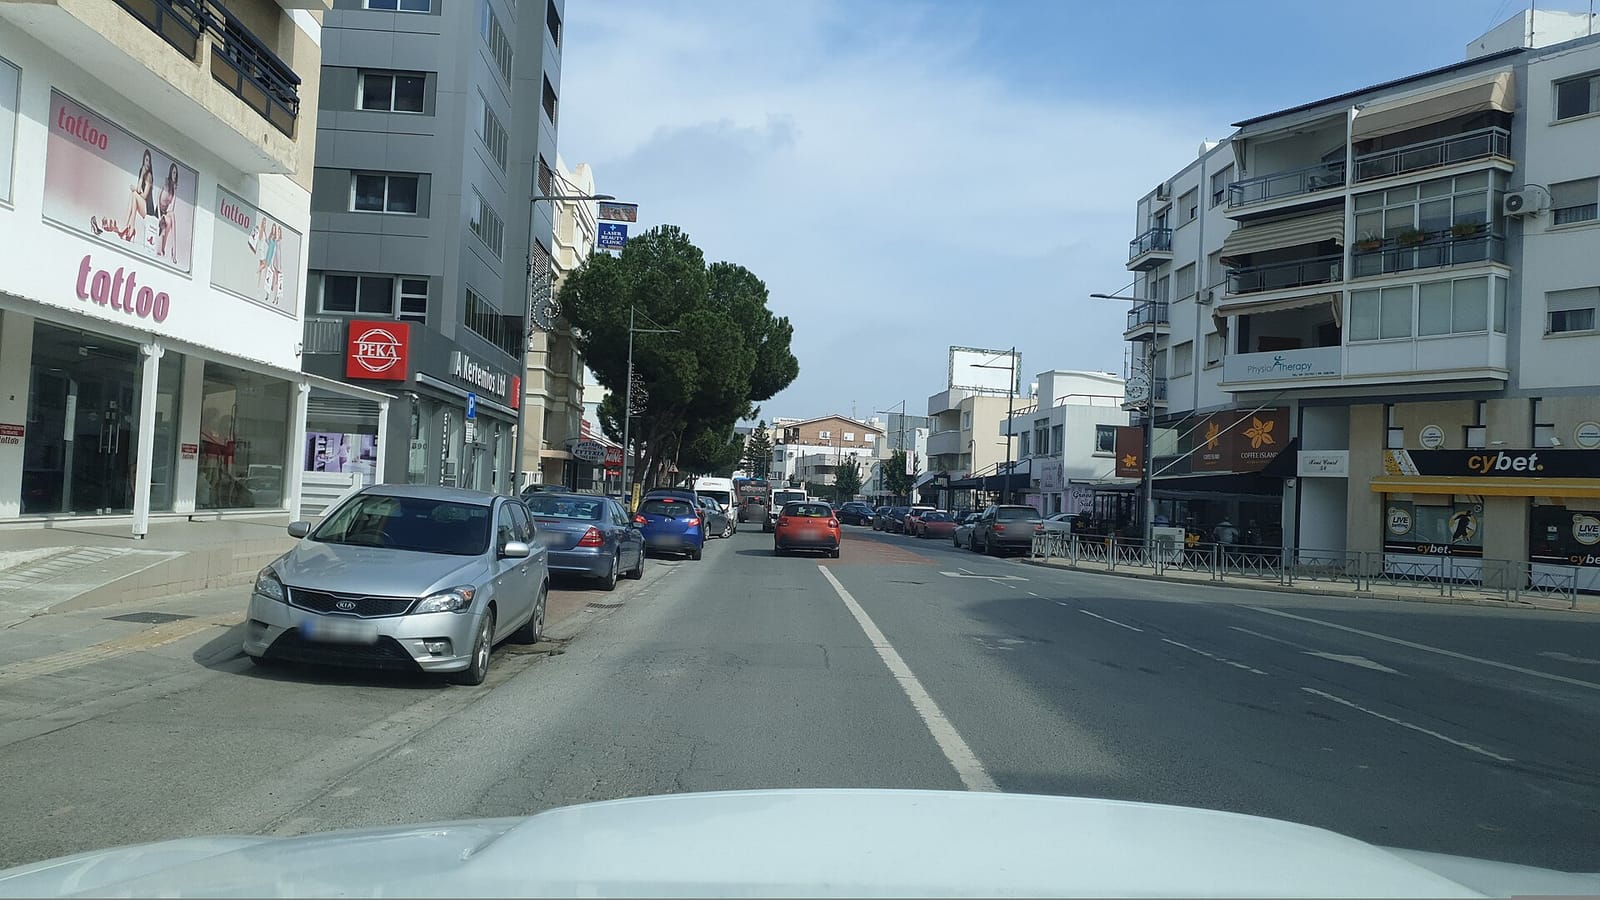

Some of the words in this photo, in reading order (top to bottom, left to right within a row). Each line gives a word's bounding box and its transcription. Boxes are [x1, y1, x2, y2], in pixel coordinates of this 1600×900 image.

[58, 106, 108, 150] tattoo
[220, 197, 251, 229] tattoo
[76, 254, 170, 323] tattoo
[359, 343, 397, 357] PEKA
[463, 354, 496, 393] Kertemios
[497, 372, 507, 397] Ltd
[468, 396, 475, 416] P
[1579, 524, 1599, 532] LIVE
